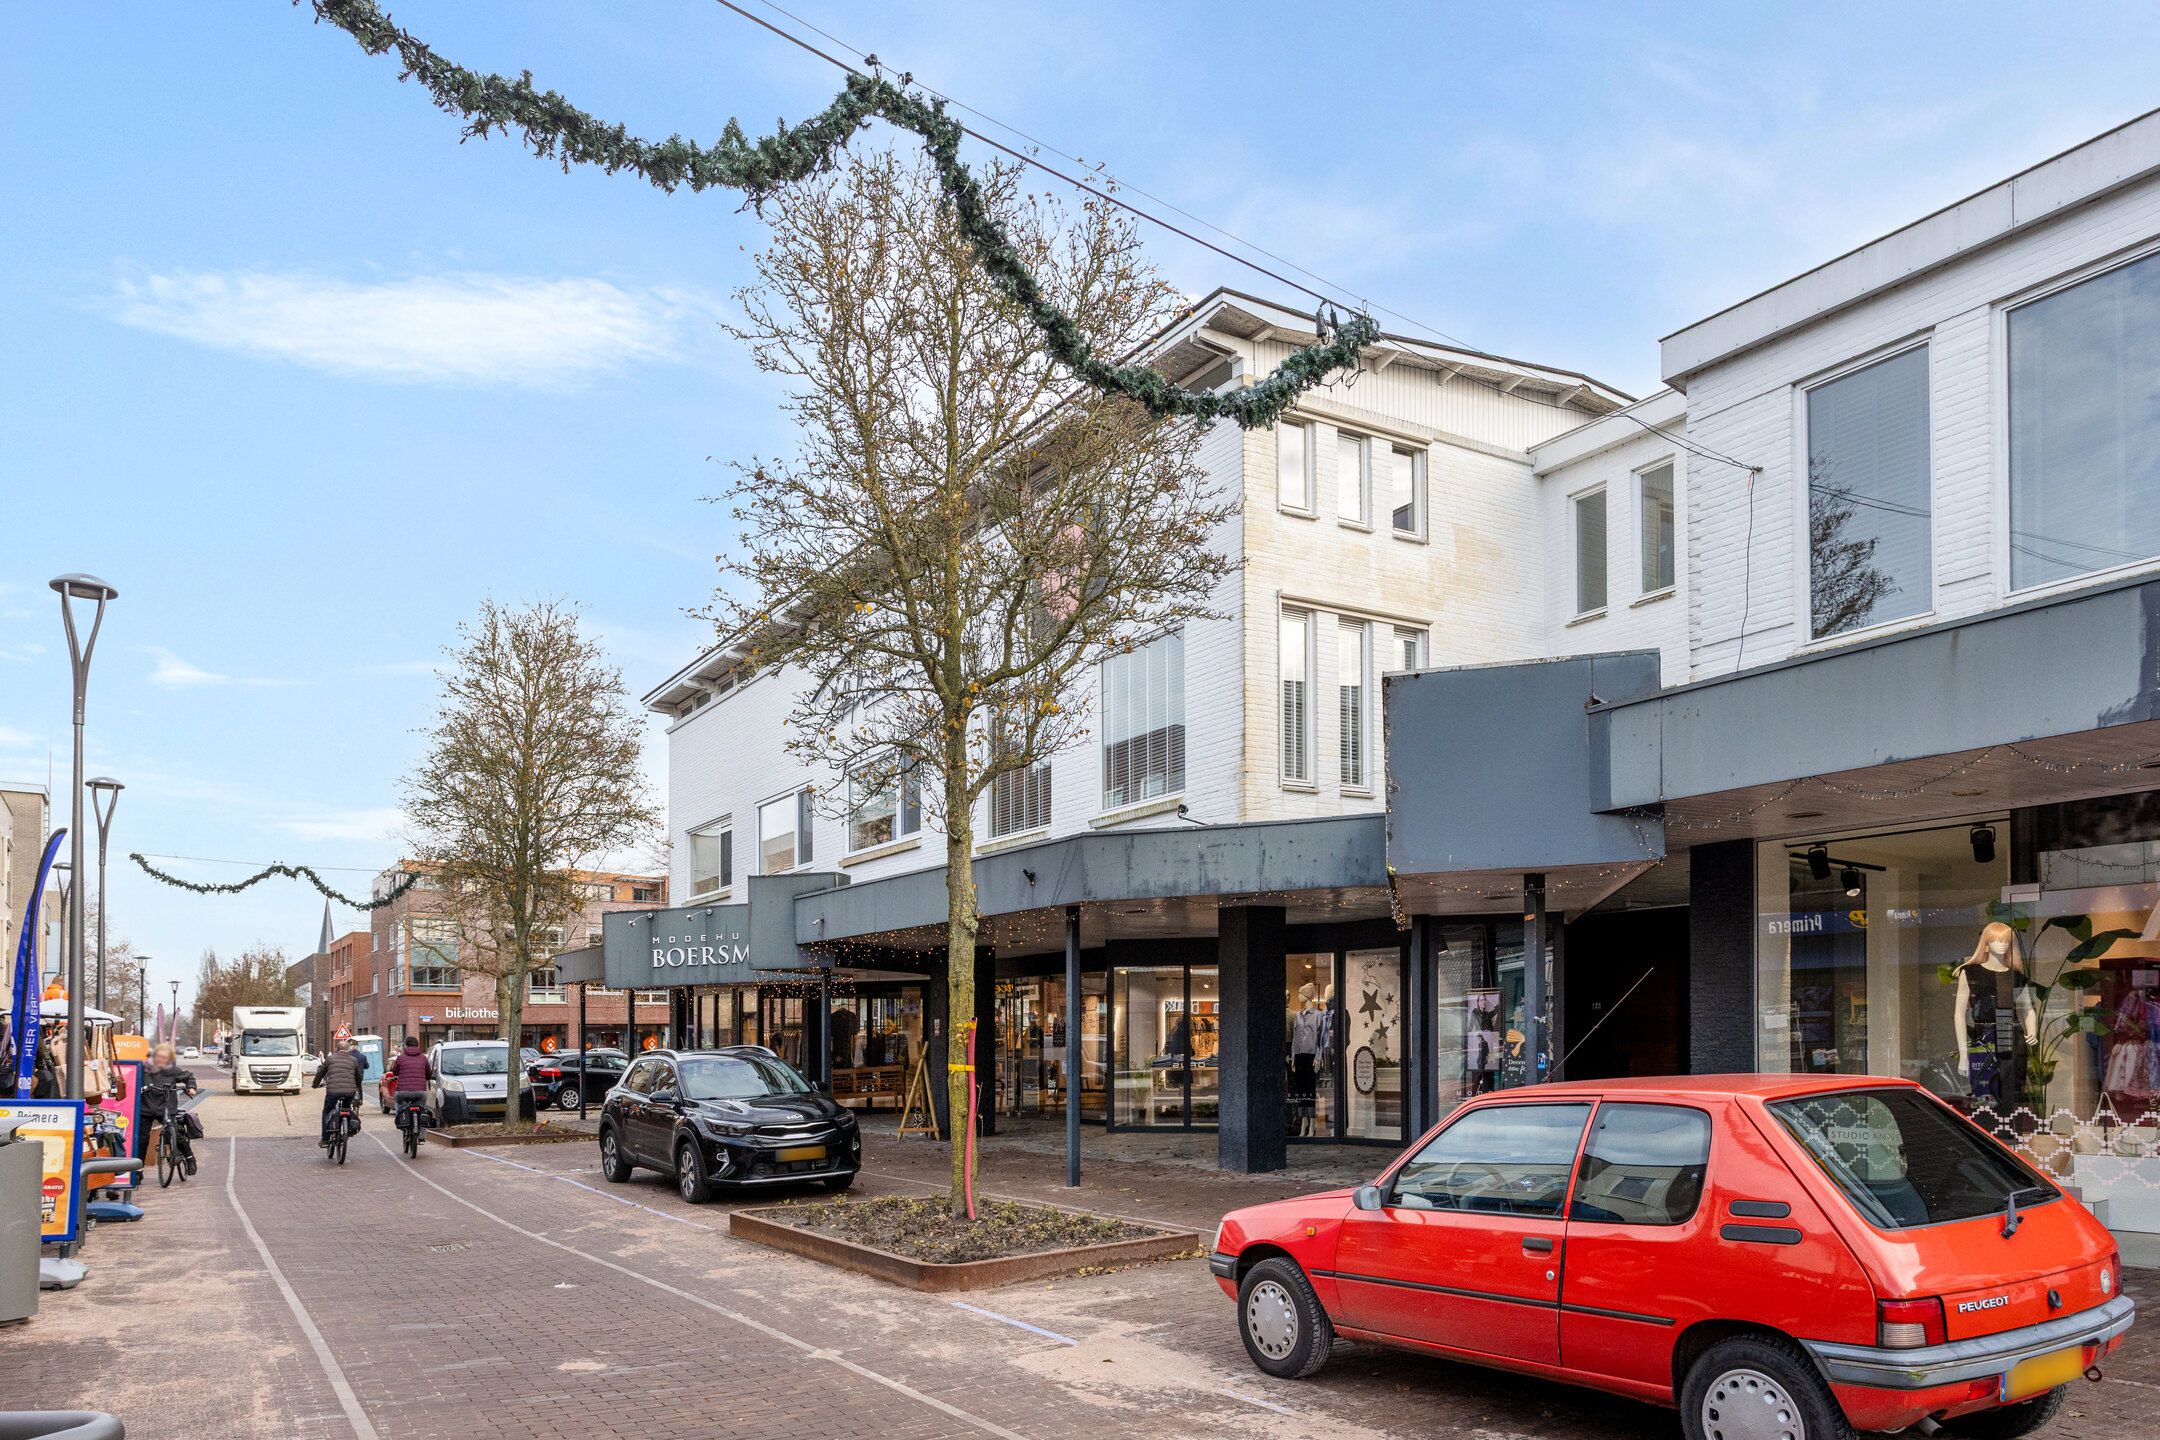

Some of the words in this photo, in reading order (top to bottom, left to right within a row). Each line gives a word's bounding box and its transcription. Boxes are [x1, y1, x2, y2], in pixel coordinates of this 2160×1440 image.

[445, 1006, 499, 1019] bibliothe
[24, 1029, 36, 1057] HIER
[1831, 1130, 1870, 1141] STUDIO
[1958, 1295, 2010, 1314] PEUGEOT
